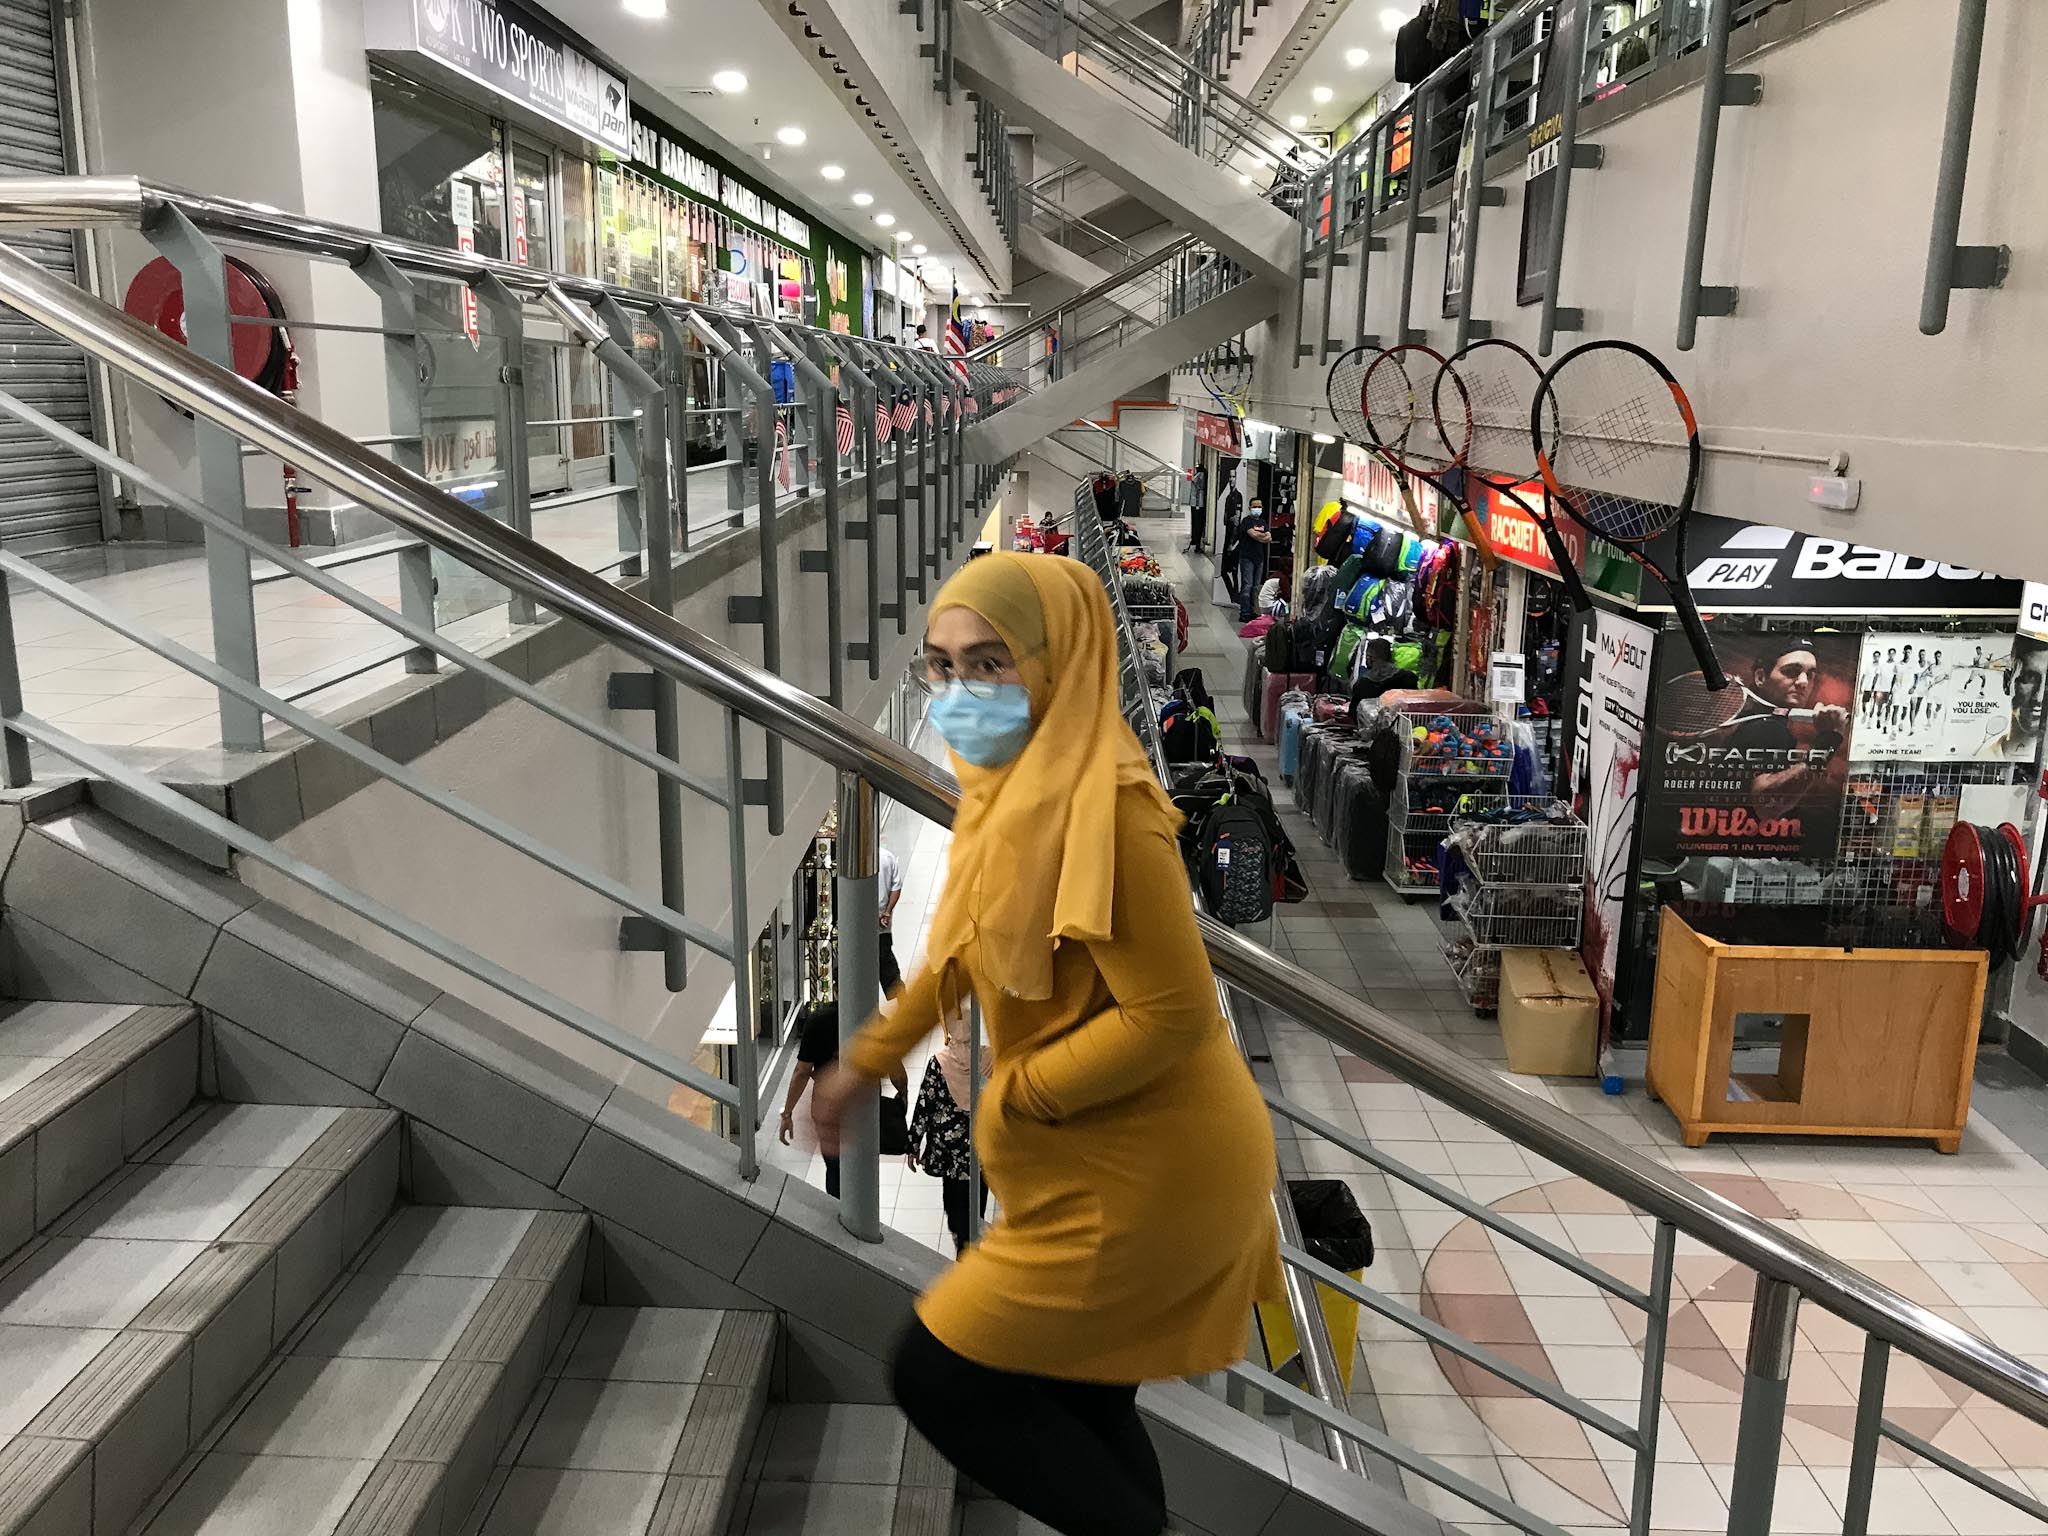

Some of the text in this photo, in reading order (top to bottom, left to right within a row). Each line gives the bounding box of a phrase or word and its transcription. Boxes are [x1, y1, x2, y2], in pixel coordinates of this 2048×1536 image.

[466, 0, 508, 70] TWO
[510, 22, 566, 102] SPORTS
[601, 111, 626, 137] pan
[630, 117, 658, 170] SAT
[660, 136, 720, 202] BARANGAN
[514, 200, 527, 263] SAL
[1491, 512, 1535, 553] RACQUET
[1706, 563, 1768, 583] PLAY
[1601, 632, 1647, 672] MAXBOLT
[1975, 701, 2000, 709] BLINK,
[1708, 747, 1829, 762] FACTOR
[1663, 779, 1742, 790] ROGER FEDERER
[1680, 806, 1802, 838] Wilson
[1676, 842, 1729, 851] NUMBER
[1741, 843, 1754, 851] IN
[1757, 843, 1801, 852] TENNIS
